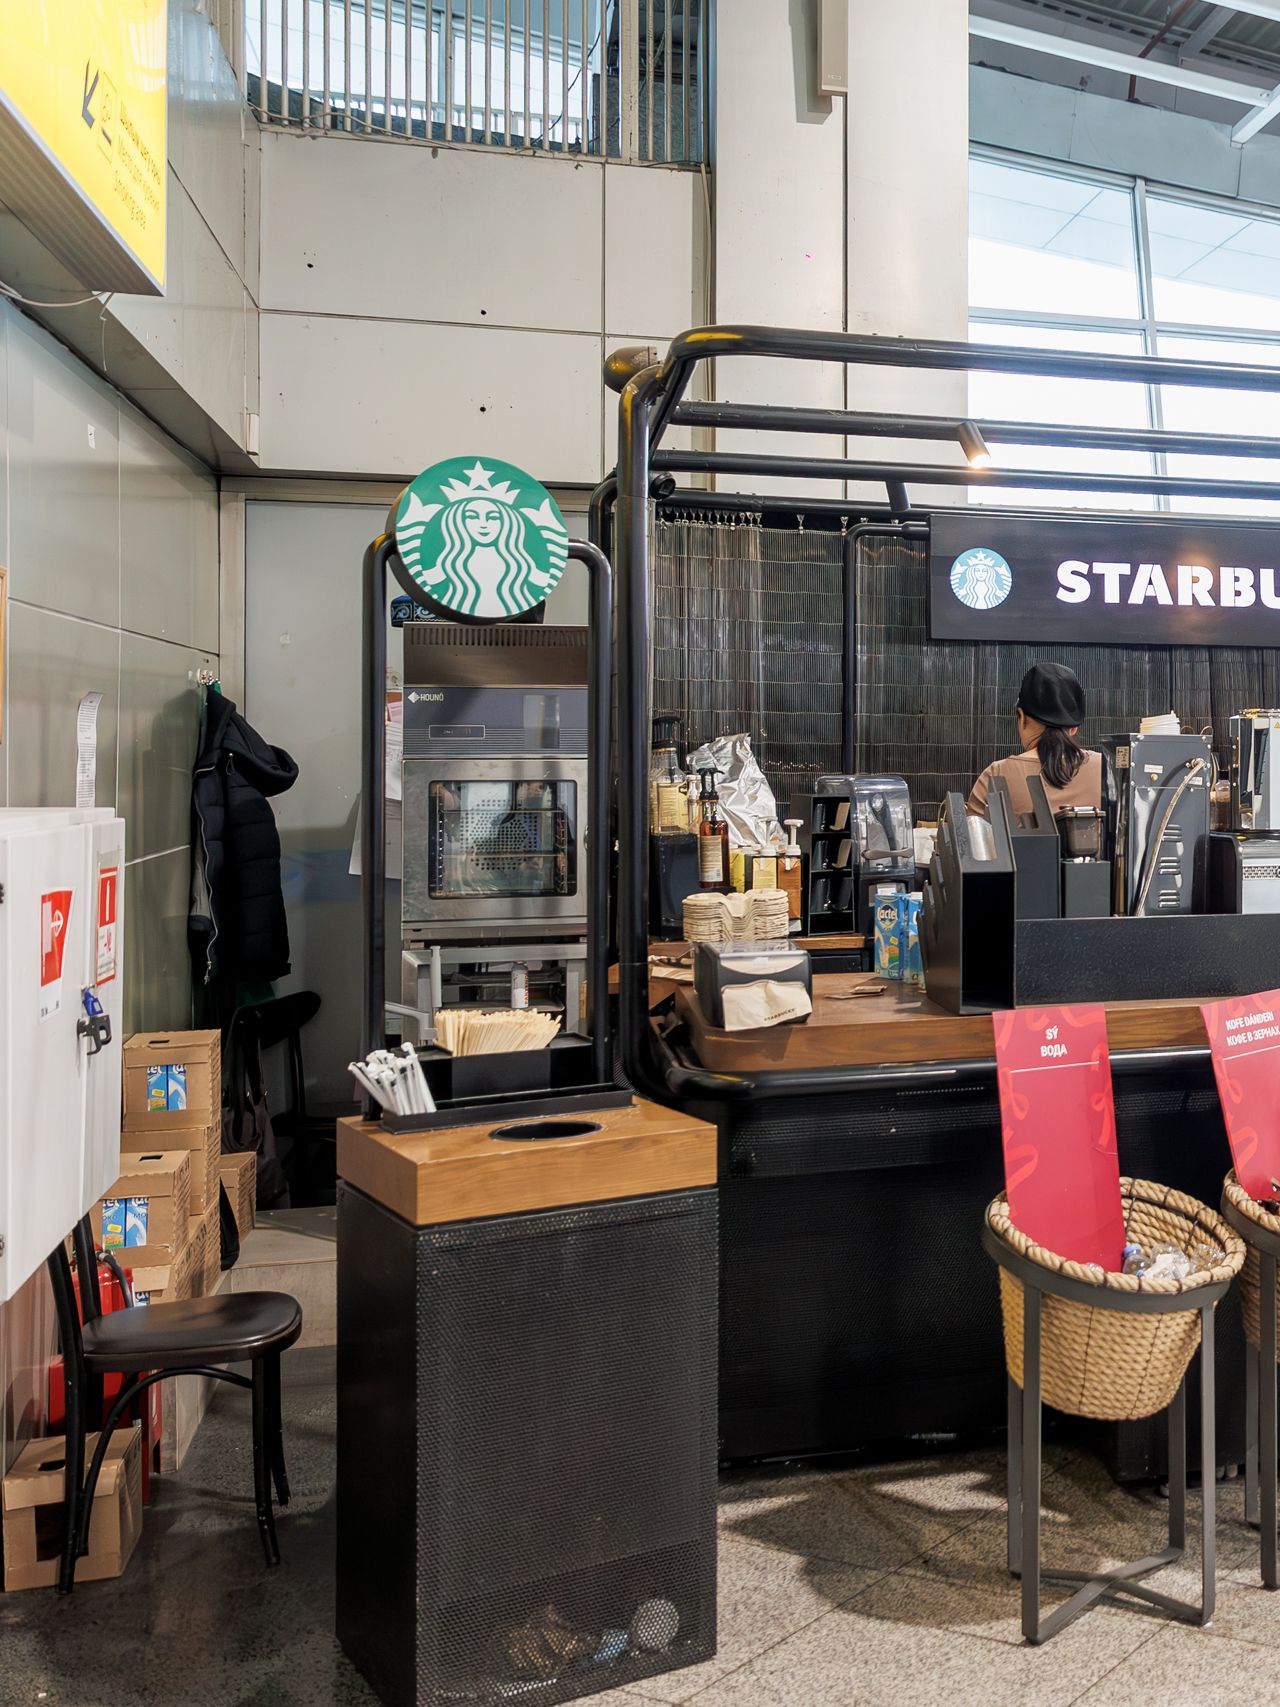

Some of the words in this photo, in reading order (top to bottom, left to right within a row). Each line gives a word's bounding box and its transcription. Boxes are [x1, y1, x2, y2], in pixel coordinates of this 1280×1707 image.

[1225, 1017, 1245, 1031] KOFE
[1244, 1011, 1275, 1027] DÁNDERI
[1226, 1032, 1248, 1047] КОФЕ
[1247, 1031, 1253, 1042] В
[1253, 1025, 1280, 1041] ЗЕРНАХ
[1040, 1043, 1068, 1058] ВОДА
